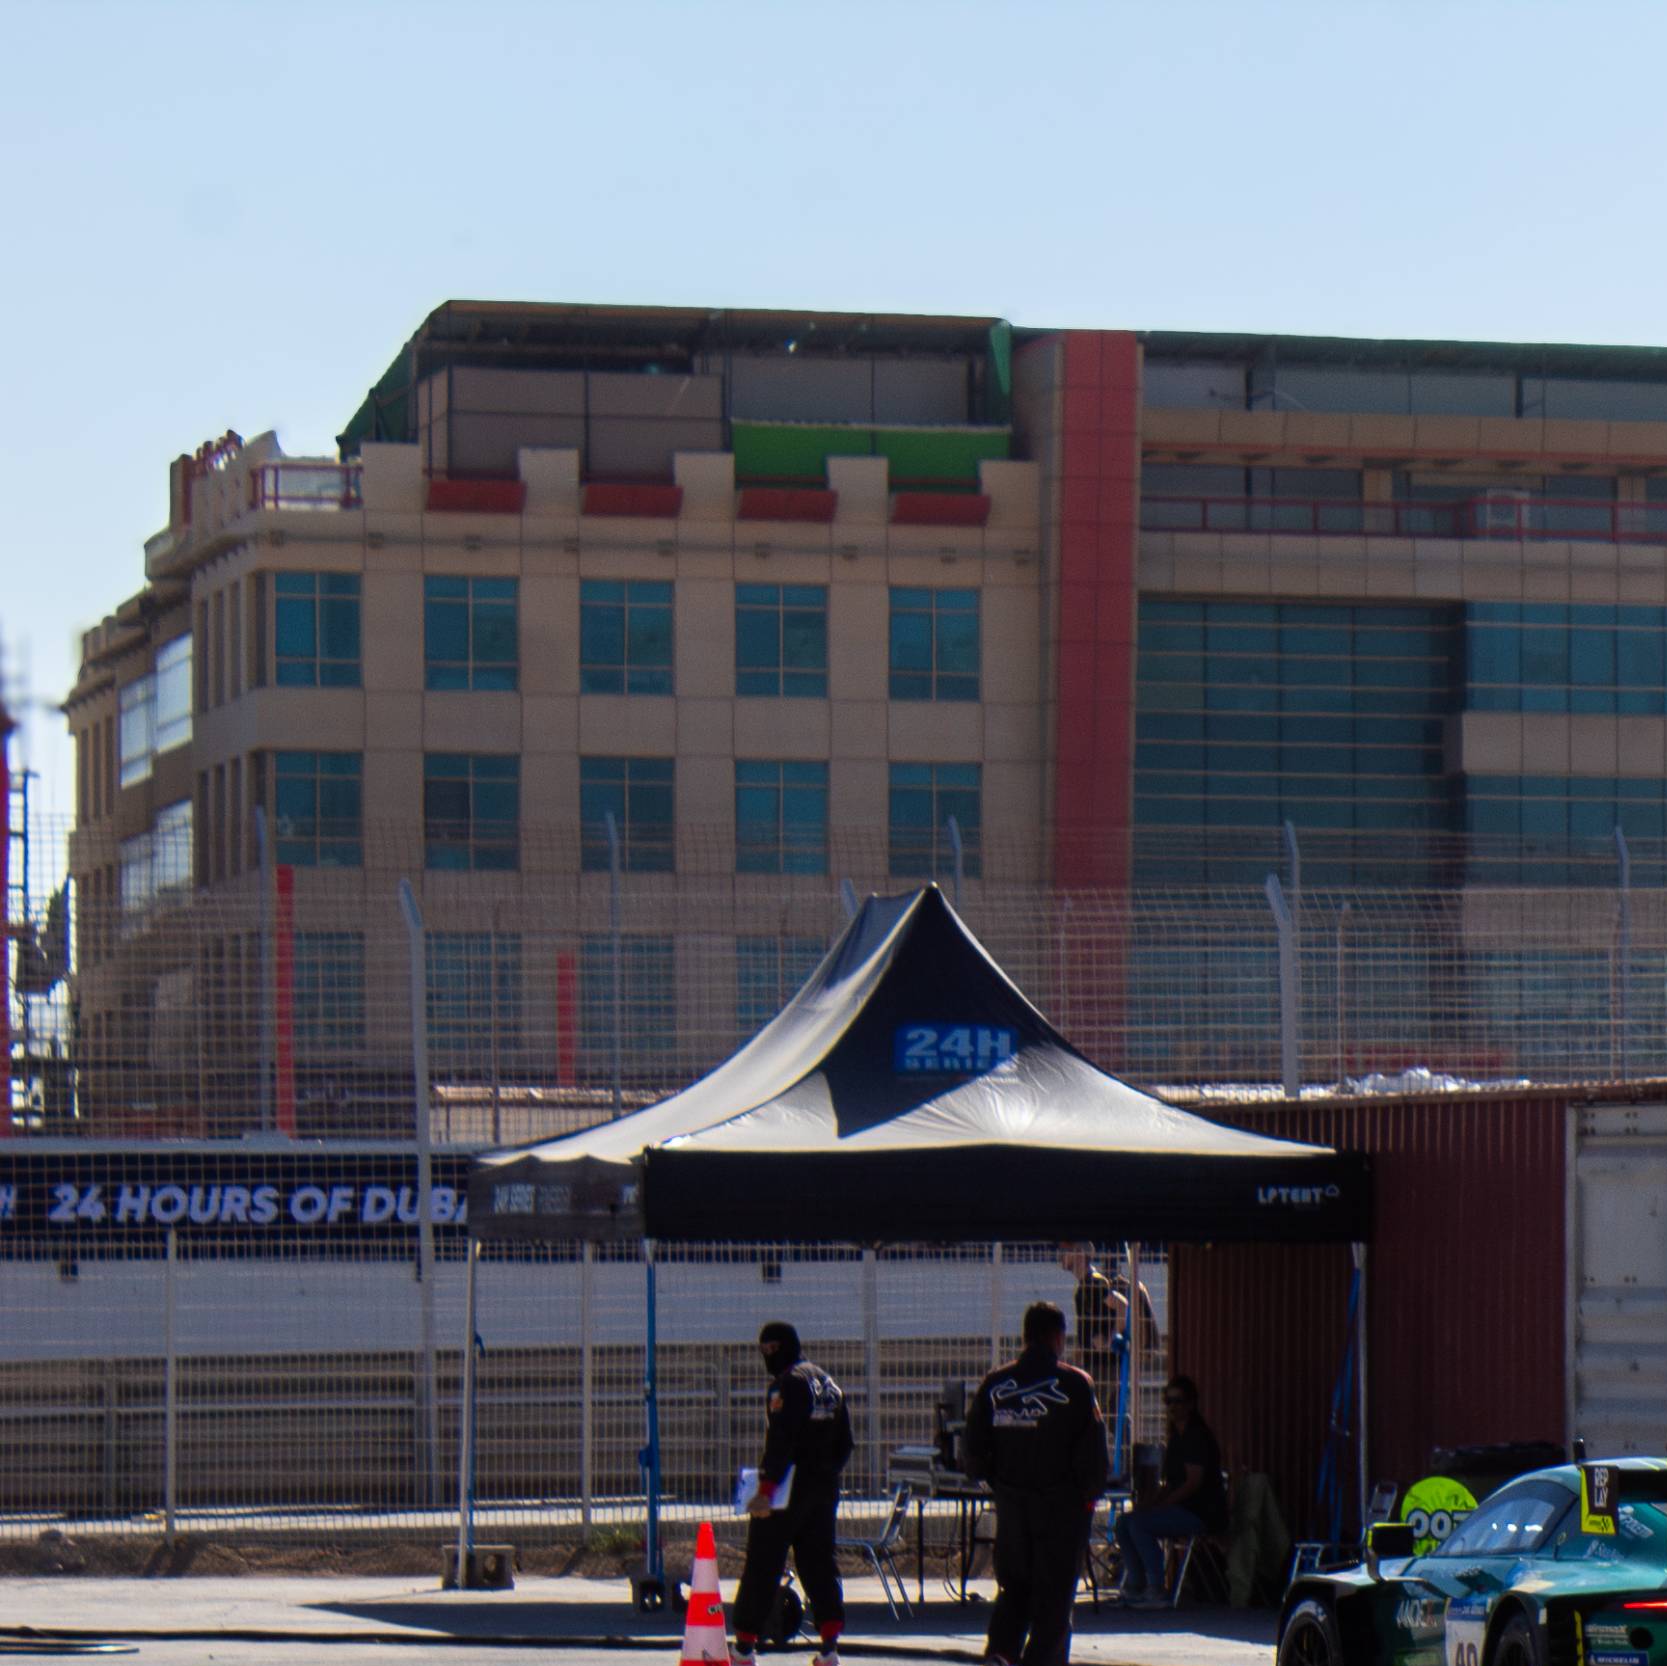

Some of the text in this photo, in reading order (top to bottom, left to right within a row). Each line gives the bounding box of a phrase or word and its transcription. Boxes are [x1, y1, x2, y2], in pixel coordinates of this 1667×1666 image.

[904, 1027, 1011, 1057] 24H
[50, 1184, 107, 1222] 24
[116, 1185, 280, 1224] HOURS
[290, 1186, 356, 1224] OF
[362, 1186, 468, 1224] DUB
